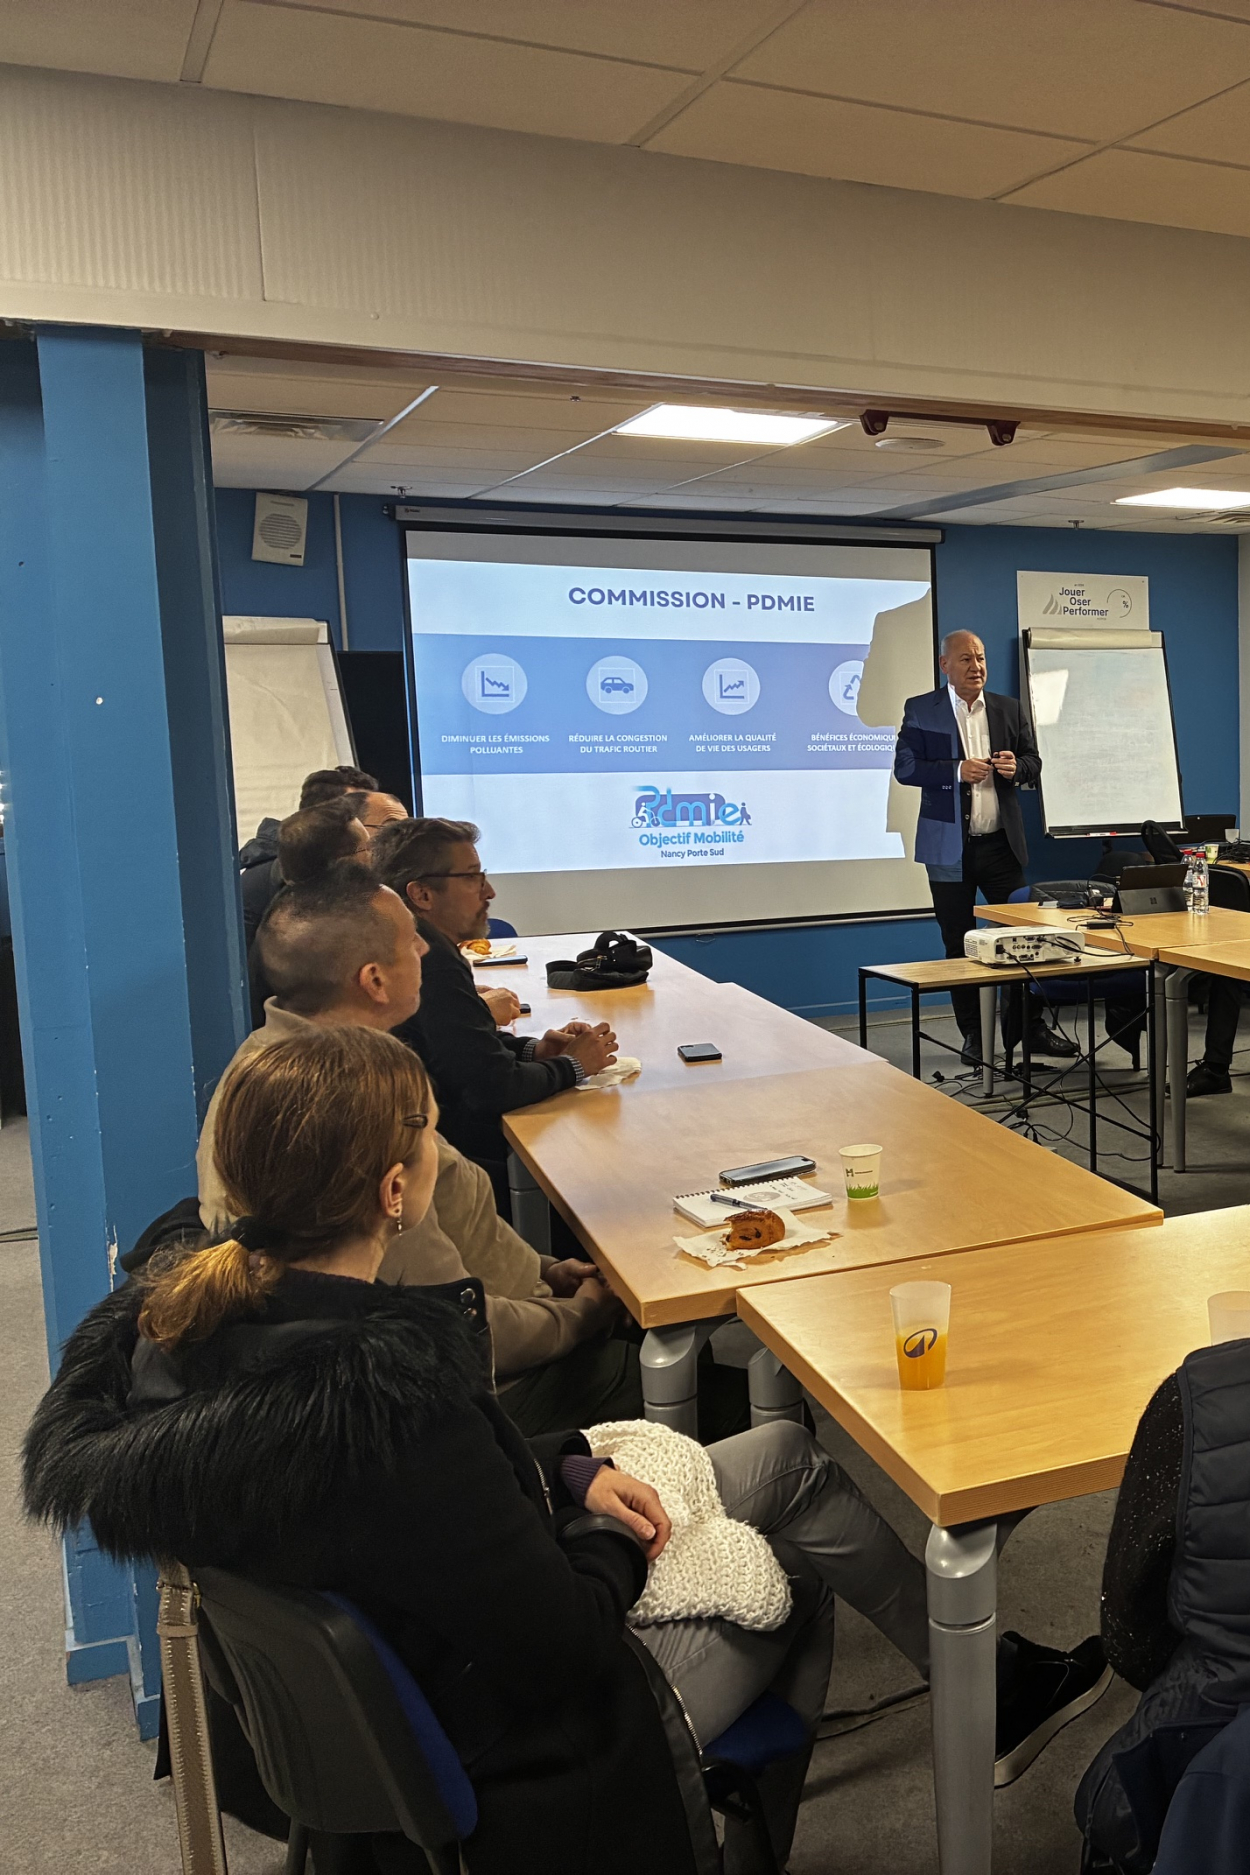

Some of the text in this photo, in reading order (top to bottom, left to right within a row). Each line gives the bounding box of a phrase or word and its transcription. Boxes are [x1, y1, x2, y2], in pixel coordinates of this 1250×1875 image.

[1059, 587, 1085, 596] Jouer
[568, 587, 725, 609] COMMISSION
[747, 594, 815, 611] PDMIE
[1069, 597, 1091, 606] Oser
[1063, 606, 1109, 616] Performer
[441, 733, 550, 743] DIMINUER LES ÉMISSIONS
[568, 733, 603, 742] RÉDUIRE
[616, 734, 668, 742] CONGESTION
[689, 733, 776, 742] AMÉLIORER LA QUALITÉ
[811, 732, 848, 741] BÉNÉFICES
[470, 746, 523, 754] POLLUANTES
[807, 742, 846, 751] SOCIÉTAUX
[639, 830, 744, 848] Objectif Mobilité
[661, 848, 725, 859] Nancy Porte Sud
